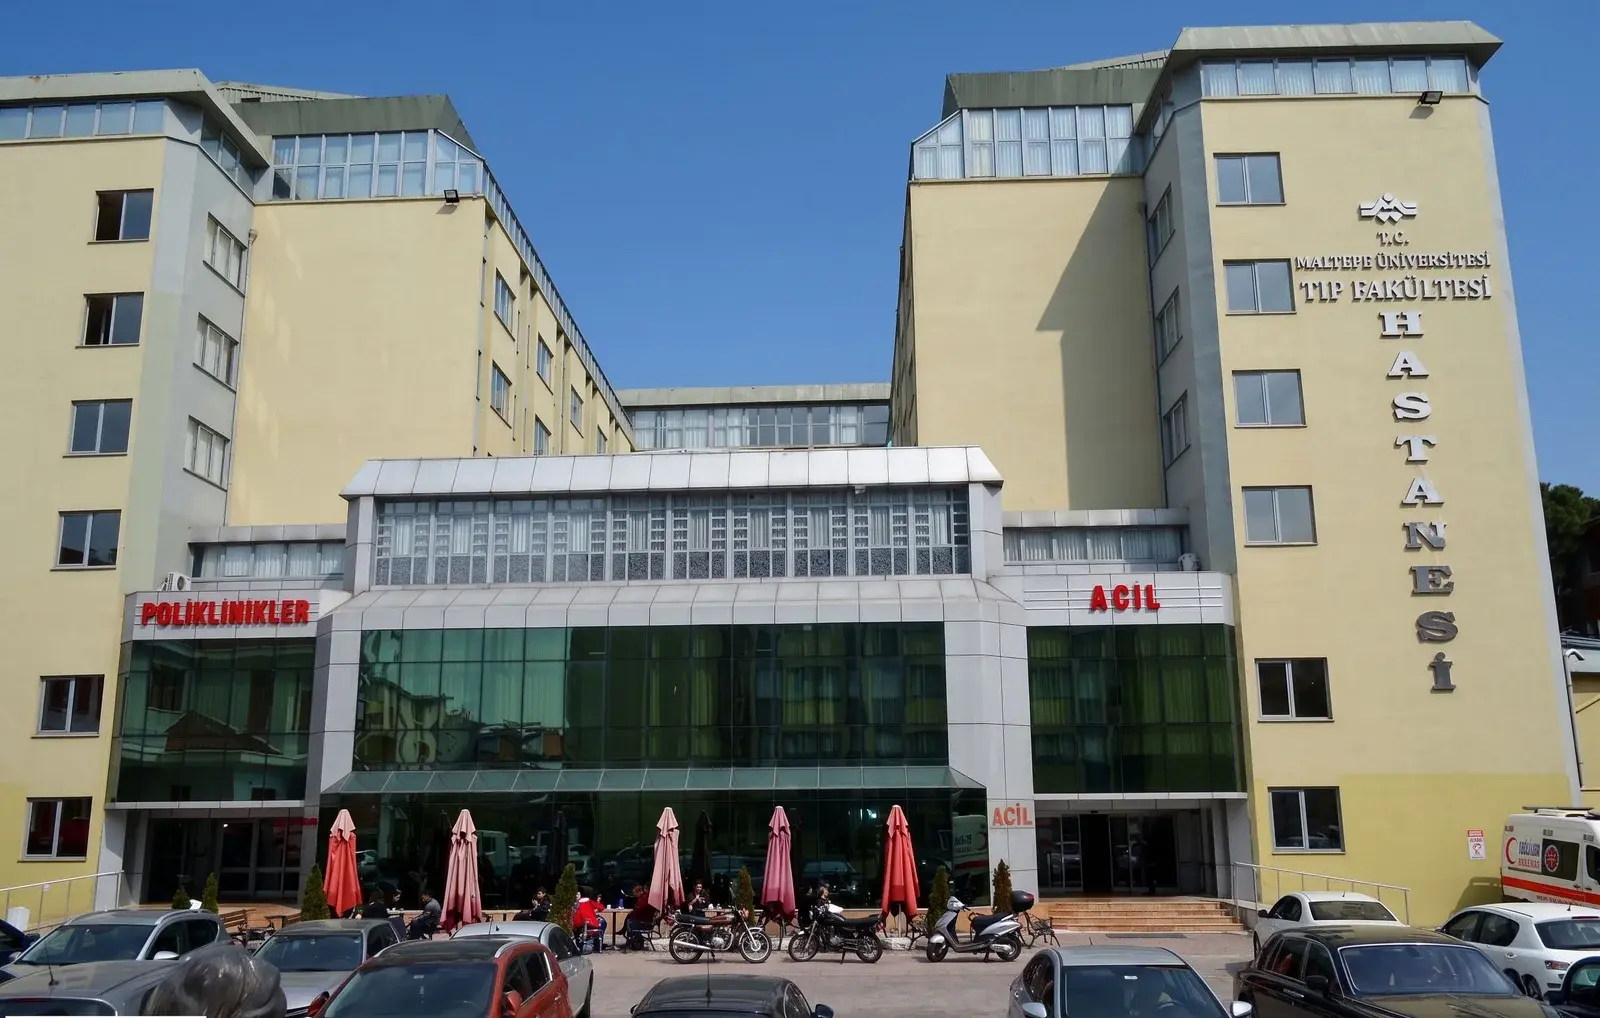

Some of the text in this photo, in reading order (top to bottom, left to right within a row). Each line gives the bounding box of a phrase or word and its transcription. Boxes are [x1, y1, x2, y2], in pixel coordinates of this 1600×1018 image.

[1377, 231, 1409, 246] T.C.
[1296, 251, 1491, 270] MALTEPE ÜNİVERSİTESİ
[1301, 274, 1492, 302] TIP FAKÜLTESİ
[1090, 581, 1161, 611] ACİL
[142, 598, 310, 626] POLİKLİNİKLER
[992, 803, 1033, 826] ACİL
